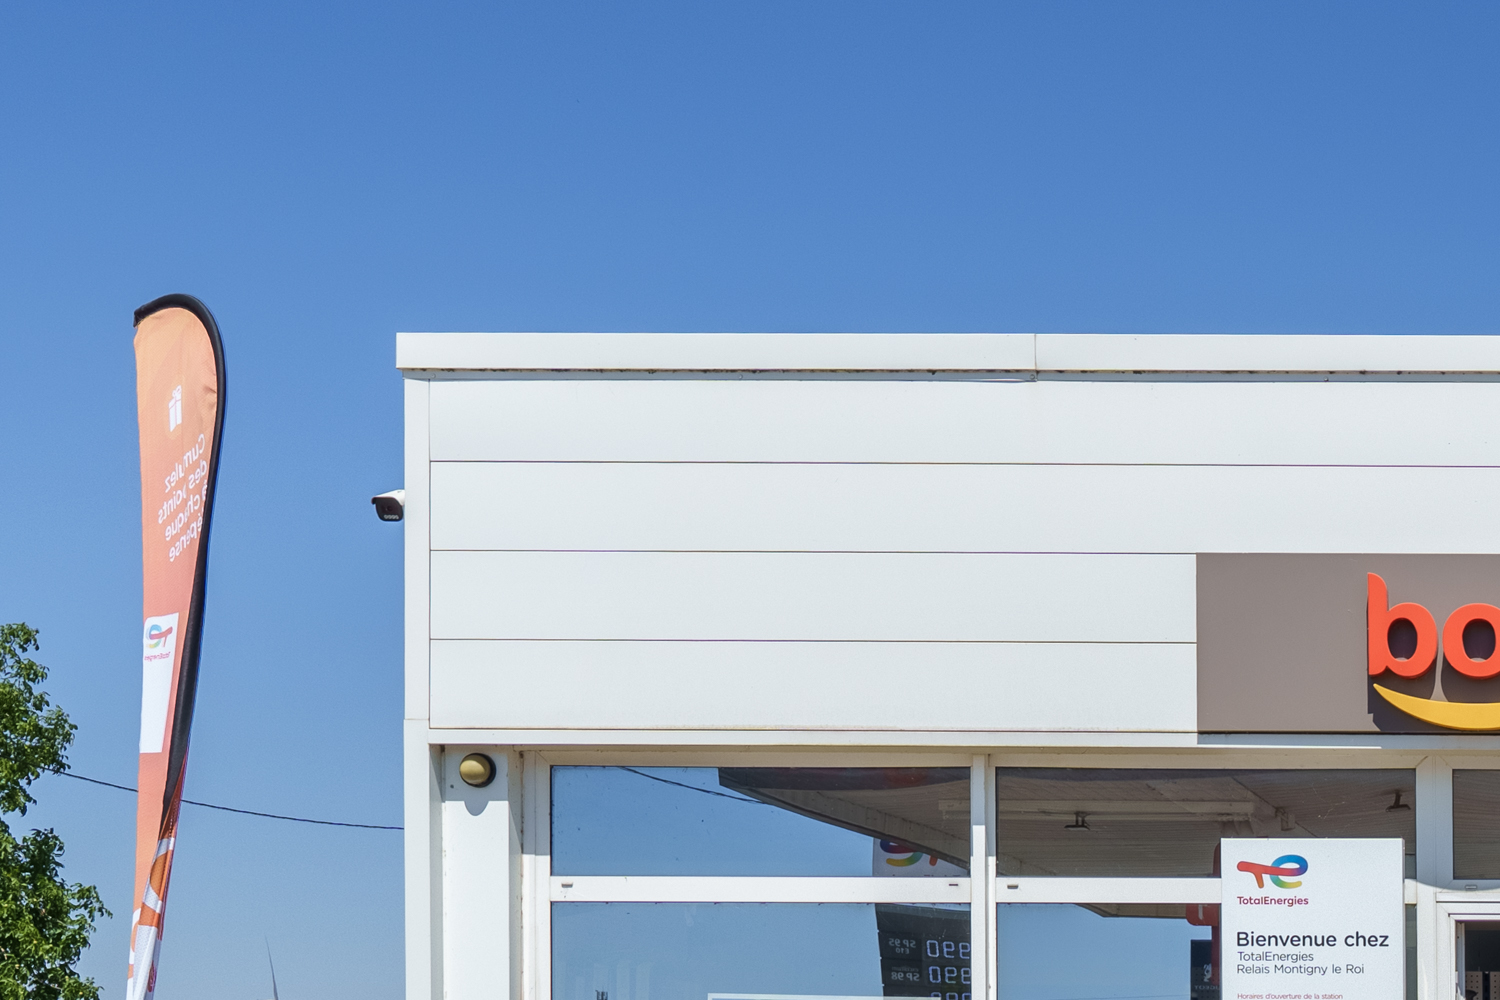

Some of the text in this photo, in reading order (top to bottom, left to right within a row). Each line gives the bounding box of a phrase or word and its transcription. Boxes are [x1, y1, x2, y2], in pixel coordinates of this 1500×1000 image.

[1237, 896, 1309, 907] TotalEnergies
[1236, 931, 1389, 947] Bienvenue chez
[1237, 951, 1314, 963] TotalEnergies
[1237, 963, 1364, 976] Relais Montigny le Roi
